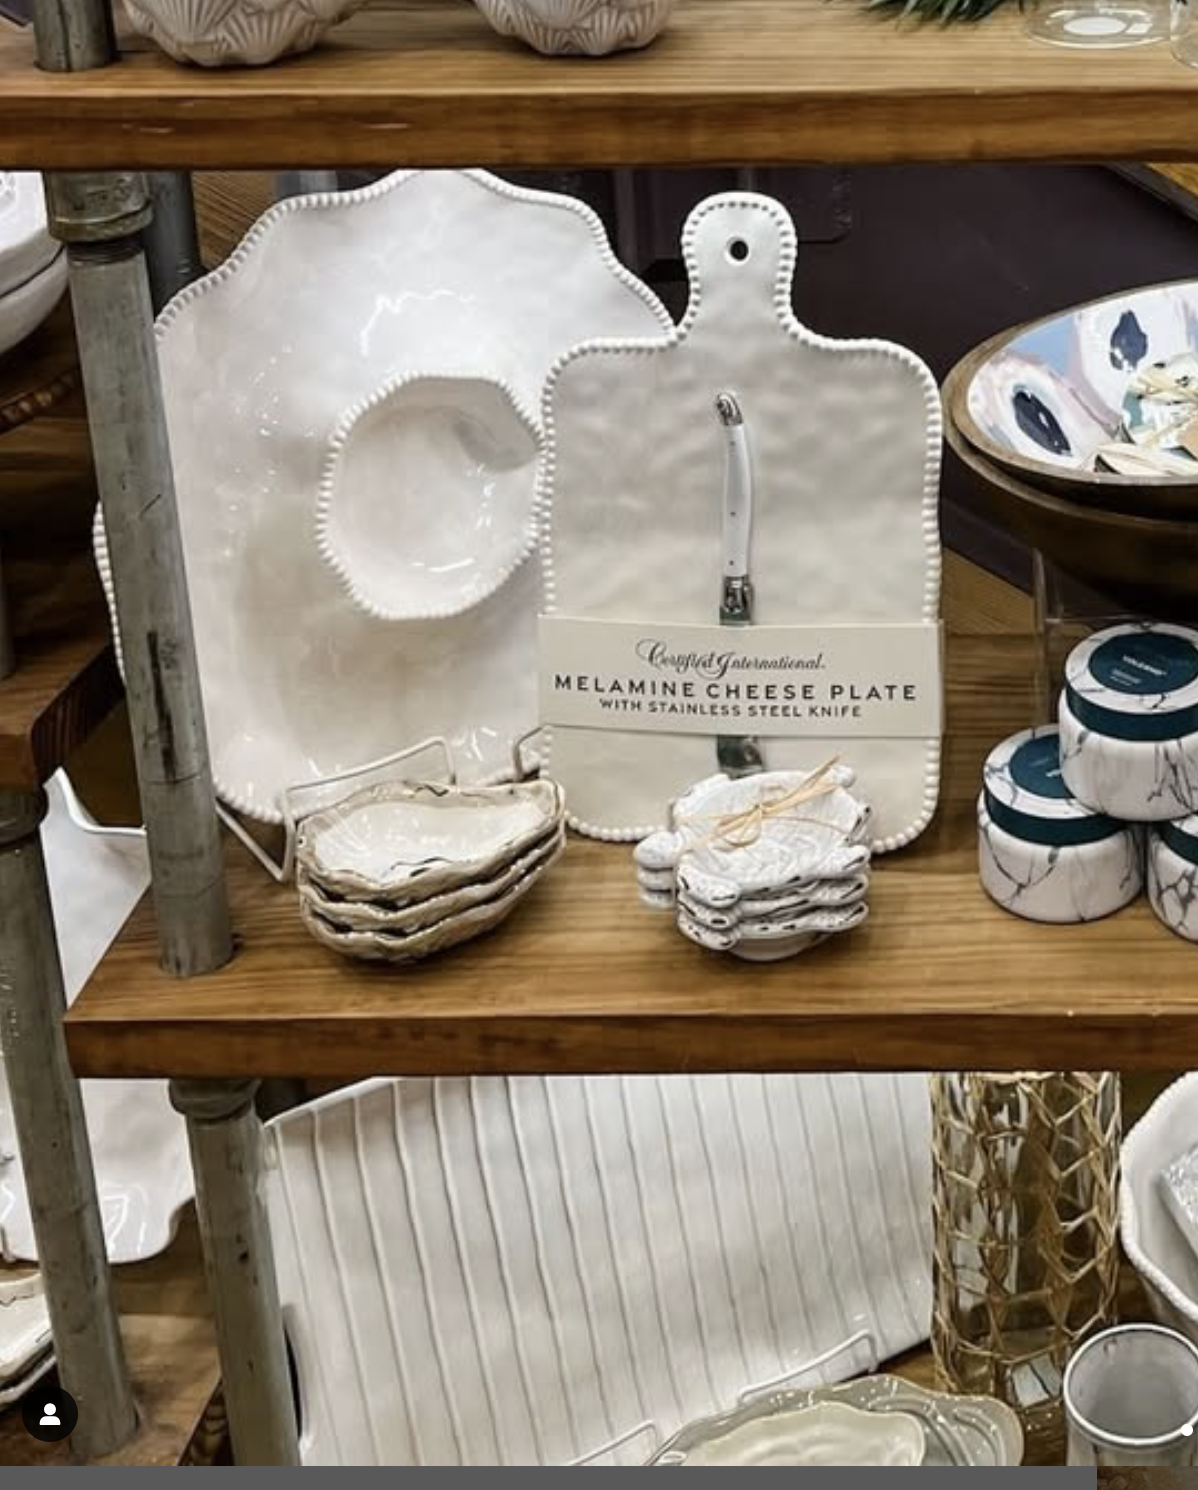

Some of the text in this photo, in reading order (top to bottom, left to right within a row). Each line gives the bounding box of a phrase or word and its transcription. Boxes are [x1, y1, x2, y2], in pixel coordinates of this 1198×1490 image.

[635, 638, 715, 674] Certified
[555, 674, 917, 701] MELAMINE CHEESE PLATE
[600, 698, 862, 718] WITH STAINLESS STEEL KNIFE
